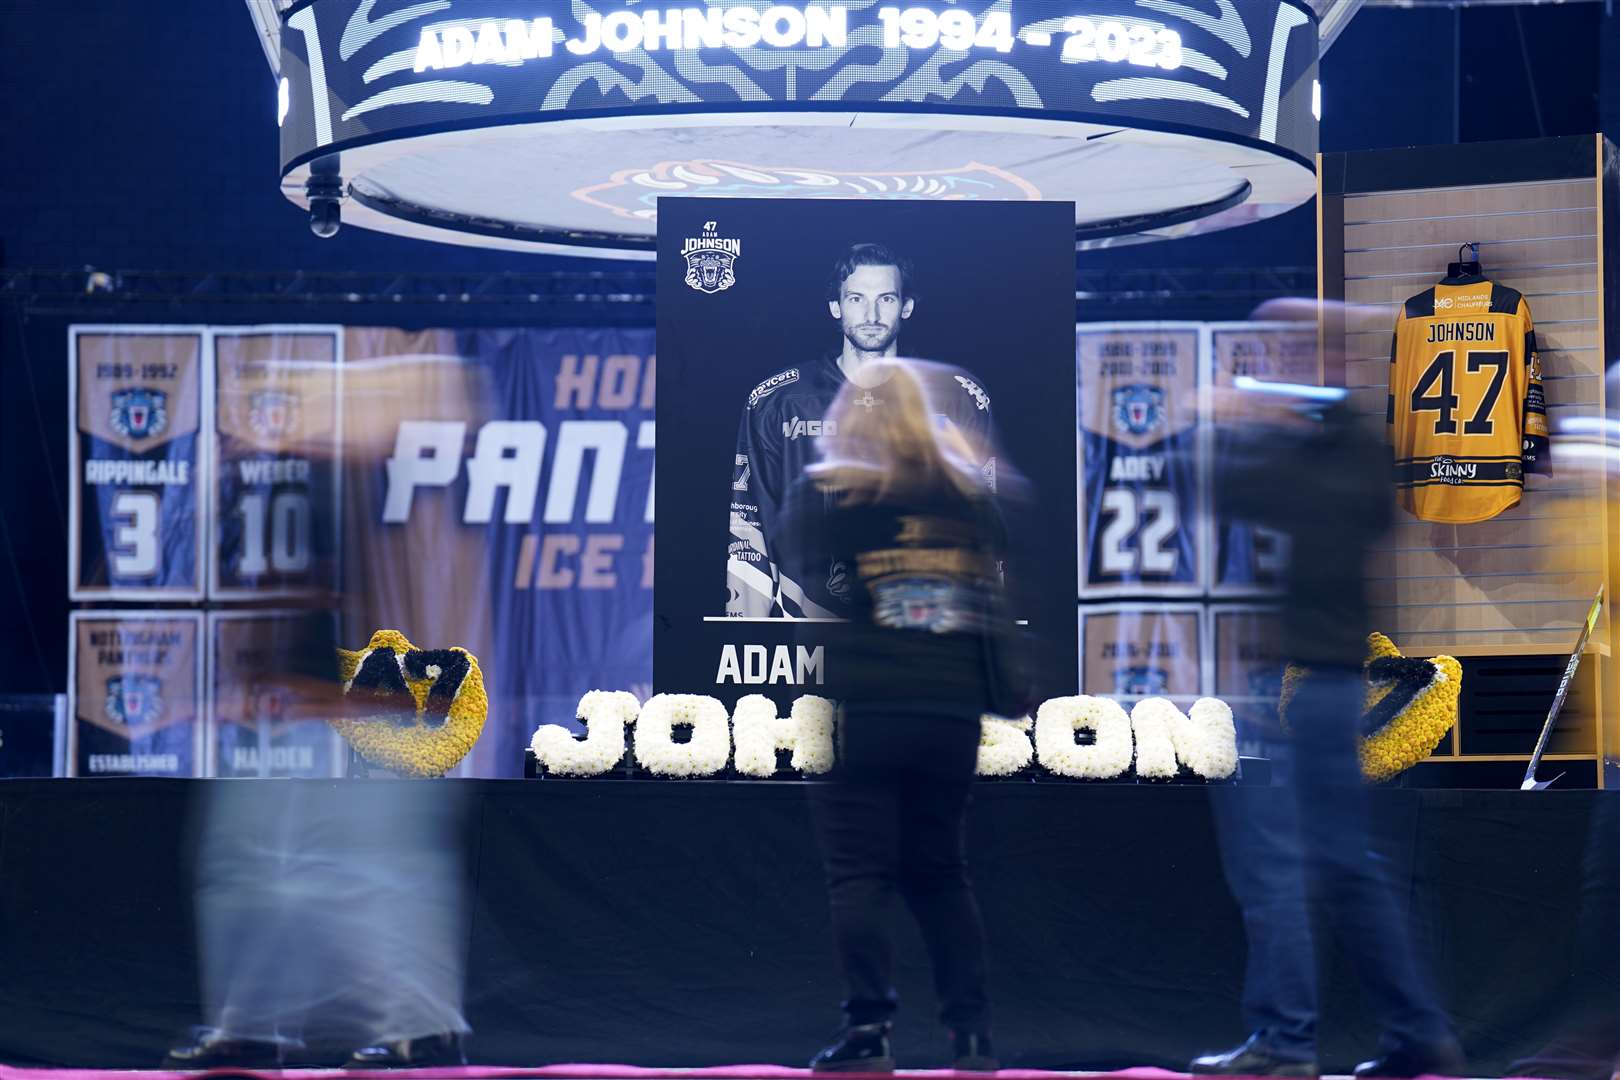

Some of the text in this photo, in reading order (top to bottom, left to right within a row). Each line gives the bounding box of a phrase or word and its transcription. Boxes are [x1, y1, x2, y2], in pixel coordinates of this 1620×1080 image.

[413, 17, 553, 73] ADAM
[565, 6, 848, 55] JOHNSON
[878, 7, 1015, 53] 1994
[1061, 16, 1184, 70] 2023
[703, 221, 717, 231] 47
[680, 238, 741, 256] JOHNSON
[1427, 322, 1494, 343] JOHNSON
[1410, 350, 1510, 437] 47
[85, 459, 190, 486] RIPPINGALE
[239, 459, 311, 486] WEBER
[1109, 456, 1166, 481] ADEY
[1430, 462, 1477, 479] SKINNY
[112, 492, 158, 578] 3
[239, 494, 309, 577] 10
[1101, 491, 1178, 574] 22
[514, 535, 624, 589] ICE
[737, 551, 761, 562] TATTOO
[716, 644, 824, 684] ADAM
